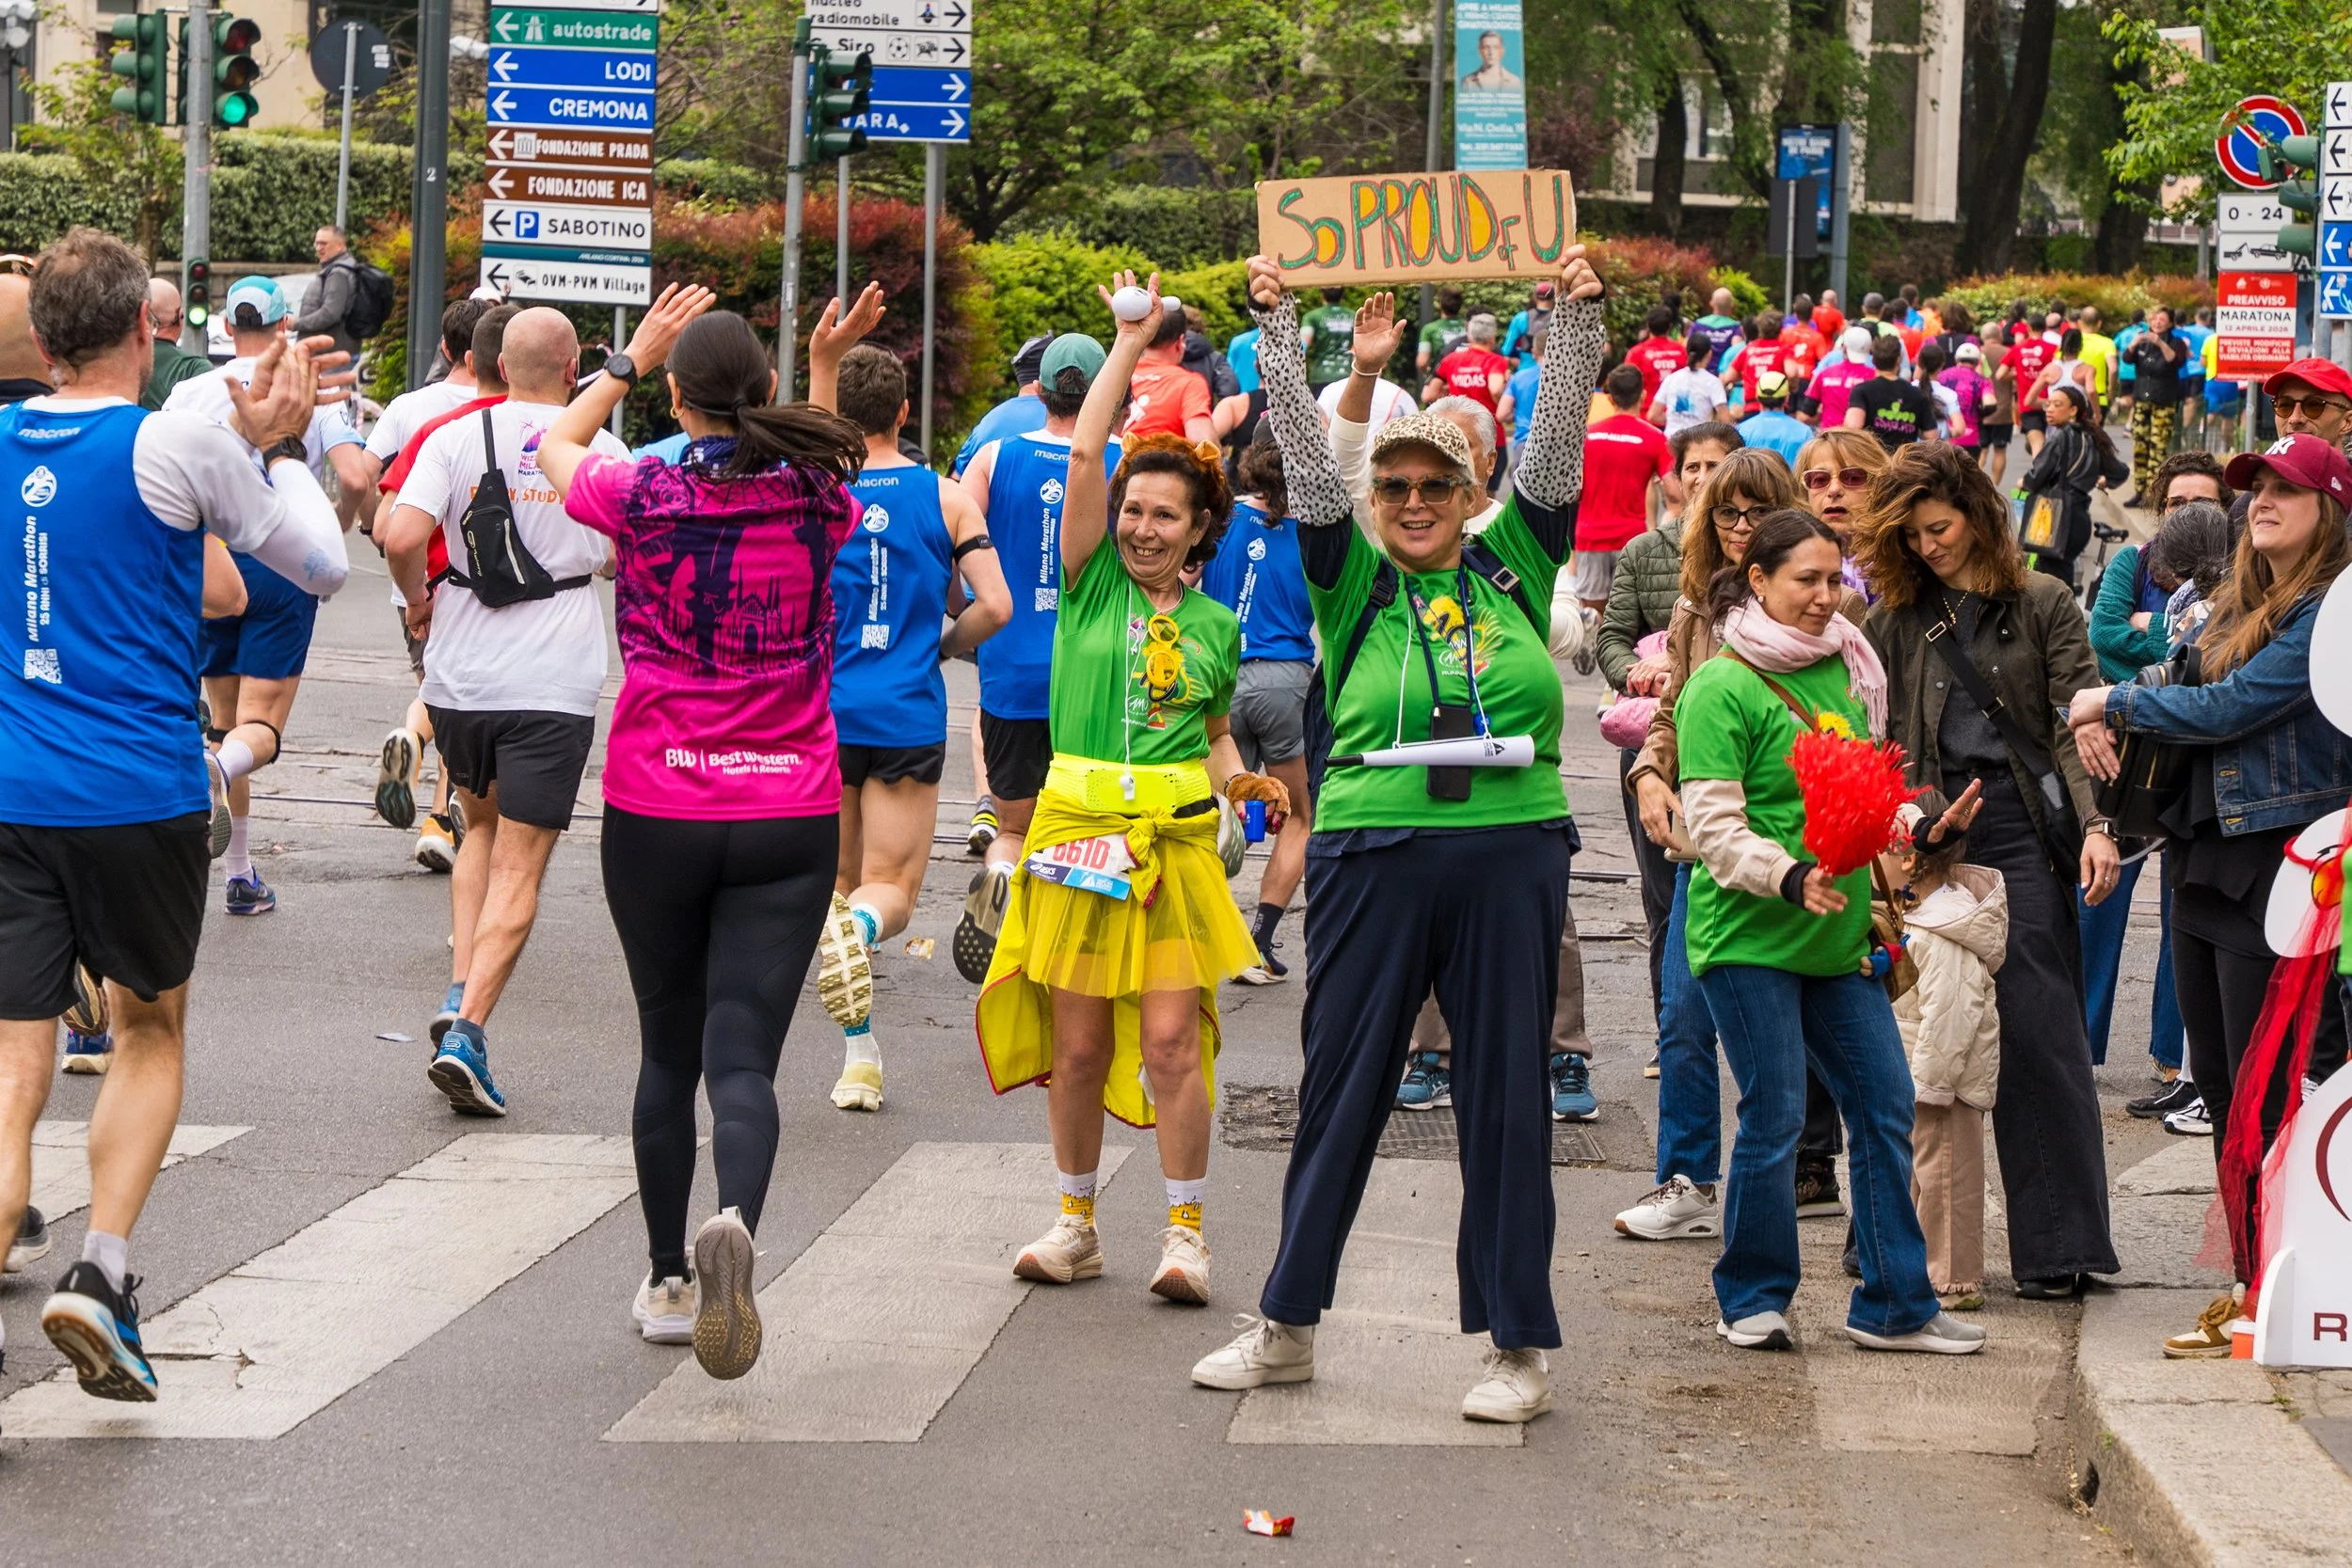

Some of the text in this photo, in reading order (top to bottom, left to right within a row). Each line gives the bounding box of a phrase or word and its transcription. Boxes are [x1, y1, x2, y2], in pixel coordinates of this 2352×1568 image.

[811, 12, 899, 26] radiomobile
[552, 22, 652, 41] autostrade
[605, 61, 651, 82] LODI
[548, 98, 648, 121] CREMONA
[536, 139, 649, 160] FONDAZIONE PRADA
[426, 166, 437, 182] 2
[528, 176, 647, 201] FONDAZIONE ICA
[1350, 172, 1499, 271] PROUD
[1523, 172, 1565, 264] U
[2228, 207, 2239, 221] 0
[2262, 207, 2283, 221] 24
[548, 218, 646, 239] SABOTINO
[603, 277, 645, 294] Village
[2227, 294, 2287, 307] PREAVVISO
[2220, 310, 2292, 322] MARATONA
[2227, 346, 2269, 355] DEVIAZIONI
[2272, 346, 2291, 355] ALLA
[18, 426, 81, 440] macron
[38, 531, 49, 575] SORRISI
[1039, 507, 1051, 585] Milano Marathon
[23, 515, 40, 642] Milano Marathon
[1239, 562, 1254, 602] Marathon
[40, 611, 51, 626] 25
[665, 748, 697, 768] BW
[708, 751, 743, 767] Best
[723, 764, 751, 775] Hotels
[759, 764, 792, 775] Resorts
